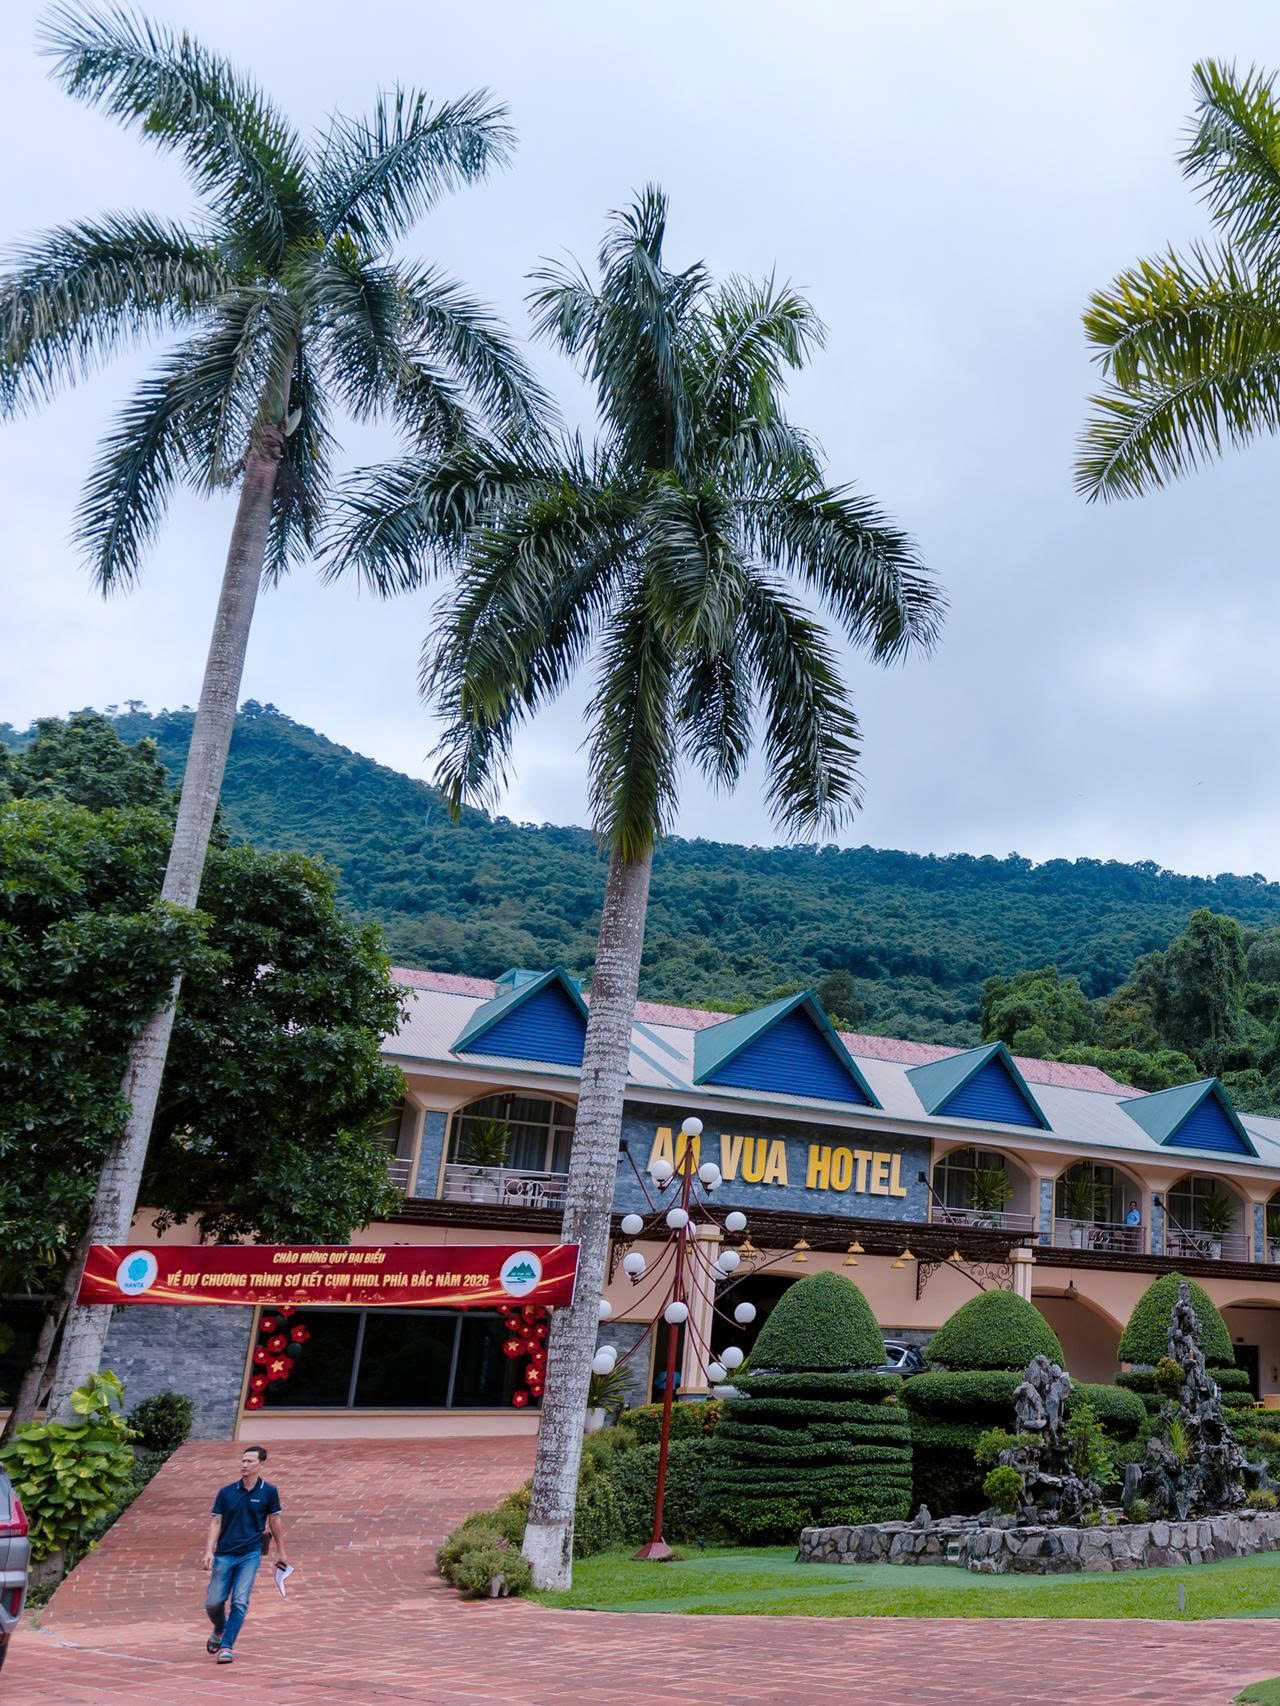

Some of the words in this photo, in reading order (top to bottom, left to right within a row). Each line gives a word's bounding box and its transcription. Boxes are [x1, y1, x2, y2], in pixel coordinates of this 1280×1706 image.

[646, 1127, 701, 1176] AO
[720, 1134, 788, 1185] VUA
[806, 1144, 907, 1197] HOTEL
[273, 1250, 299, 1264] CHÀO
[299, 1250, 328, 1264] MỪNG
[328, 1250, 348, 1264] QUÝ
[348, 1252, 364, 1266] ĐẠI
[363, 1248, 387, 1264] BIỂU
[182, 1272, 200, 1289] DỰ
[201, 1272, 248, 1287] CHƯƠNG
[250, 1271, 283, 1287] TRÌNH
[283, 1272, 301, 1287] SƠ
[301, 1270, 323, 1287] KẾT
[325, 1273, 350, 1289] CỤM
[352, 1274, 380, 1287] HHDL
[382, 1271, 408, 1287] PHÍA
[411, 1269, 433, 1287] BẮC
[435, 1271, 461, 1287] NĂM
[463, 1274, 489, 1287] 2026
